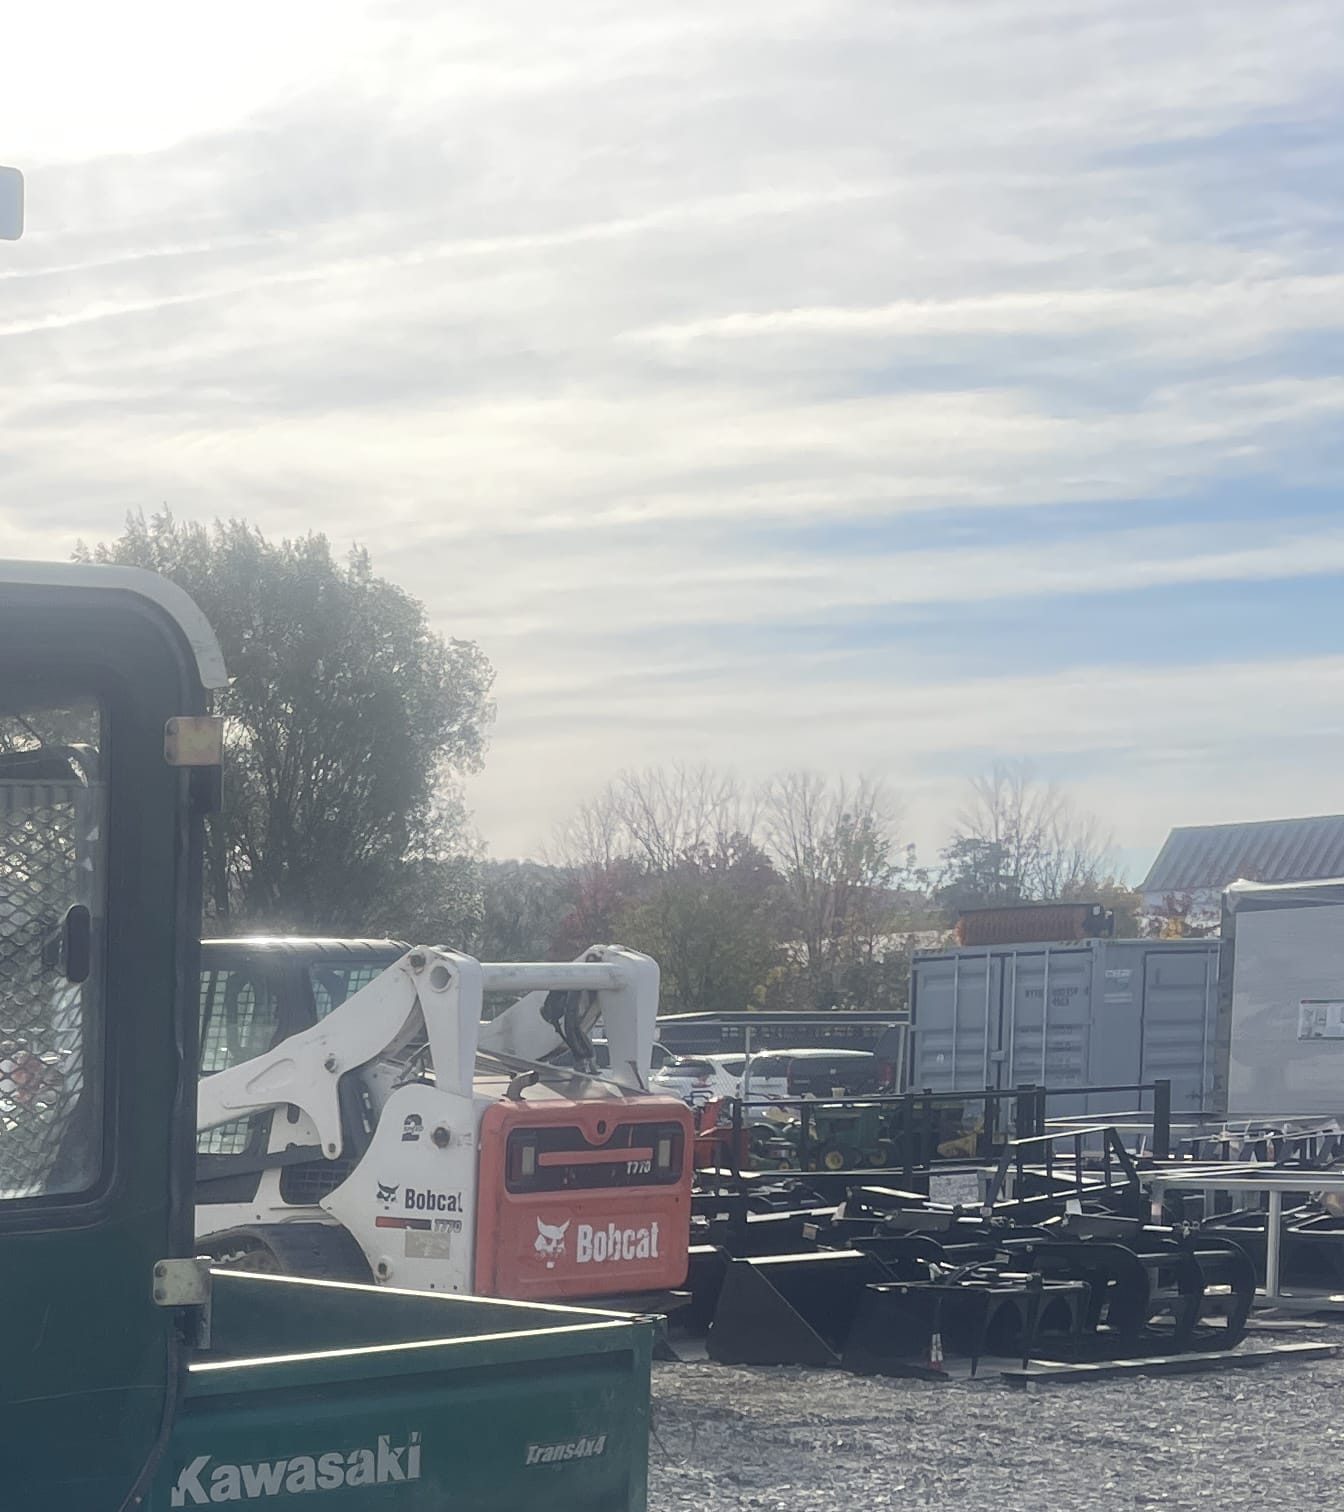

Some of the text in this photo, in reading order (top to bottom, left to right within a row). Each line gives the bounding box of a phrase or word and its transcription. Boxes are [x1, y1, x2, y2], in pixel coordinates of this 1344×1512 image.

[405, 1188, 463, 1213] Bobcat
[576, 1221, 659, 1263] Bobcat
[171, 1431, 422, 1507] Kawasaki
